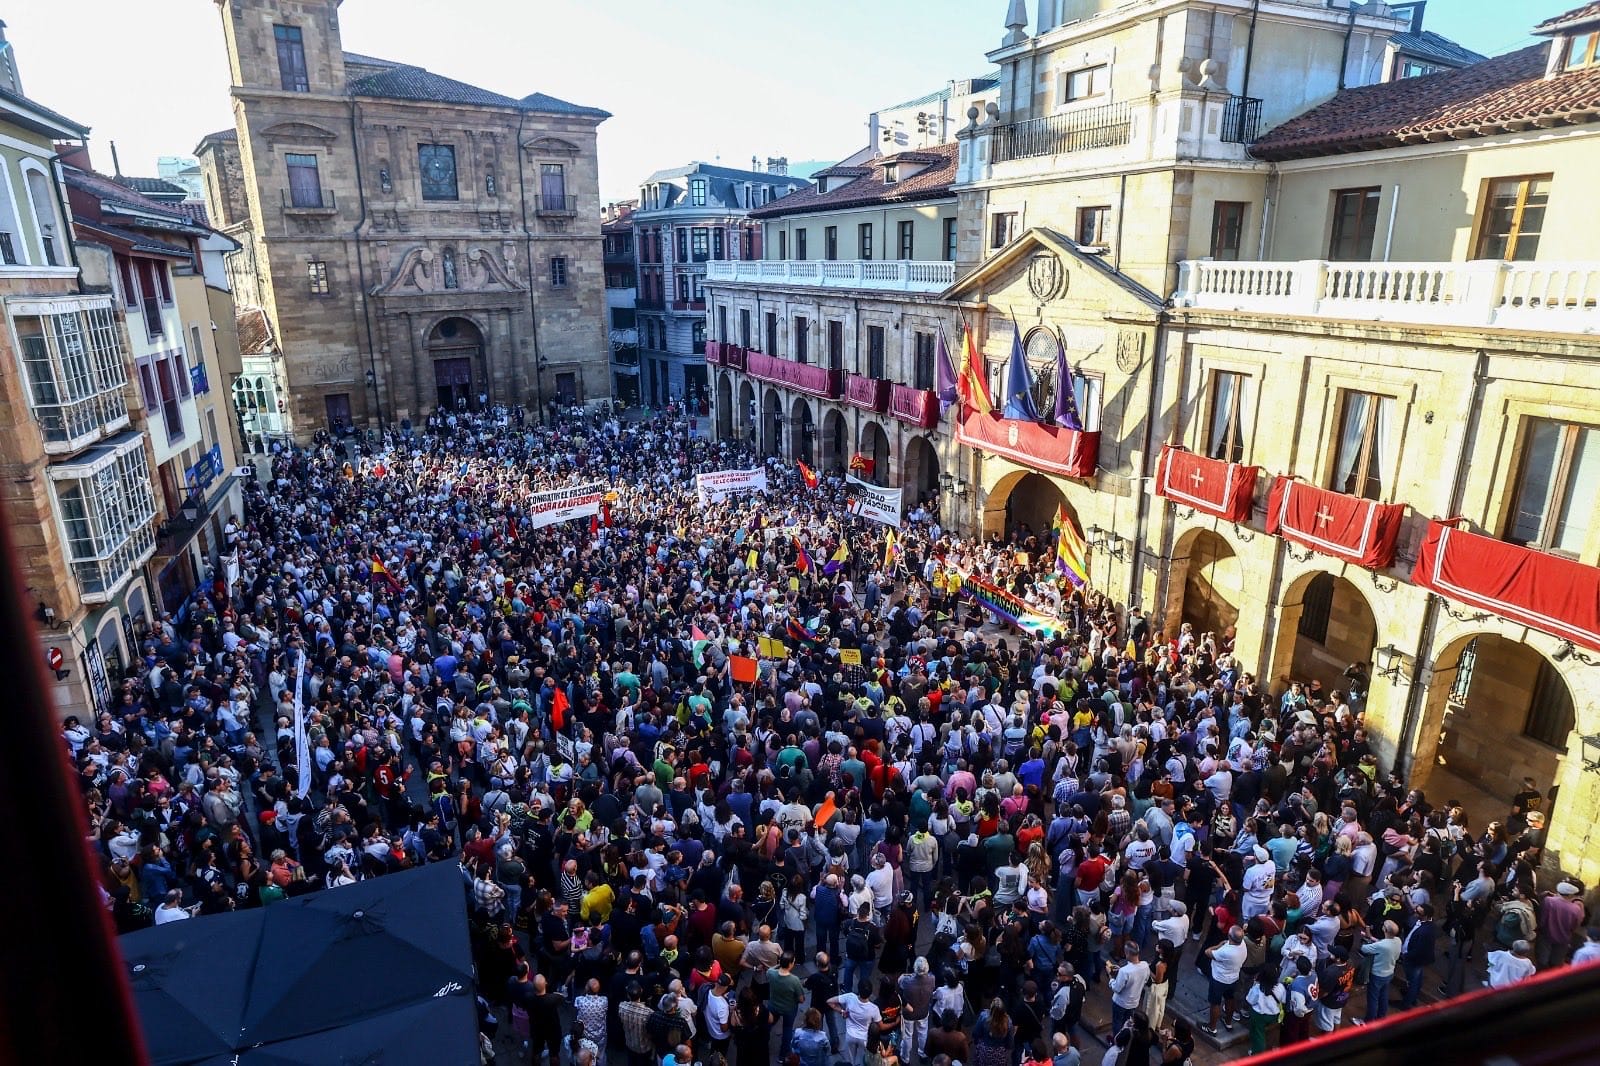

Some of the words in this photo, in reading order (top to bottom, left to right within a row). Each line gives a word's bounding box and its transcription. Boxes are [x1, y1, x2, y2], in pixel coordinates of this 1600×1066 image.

[561, 490, 568, 499] EL
[569, 483, 603, 498] FASCISMO
[531, 502, 552, 515] PASAR
[551, 502, 557, 510] A
[557, 500, 567, 509] LA
[980, 584, 988, 599] EL
[380, 769, 388, 785] 5
